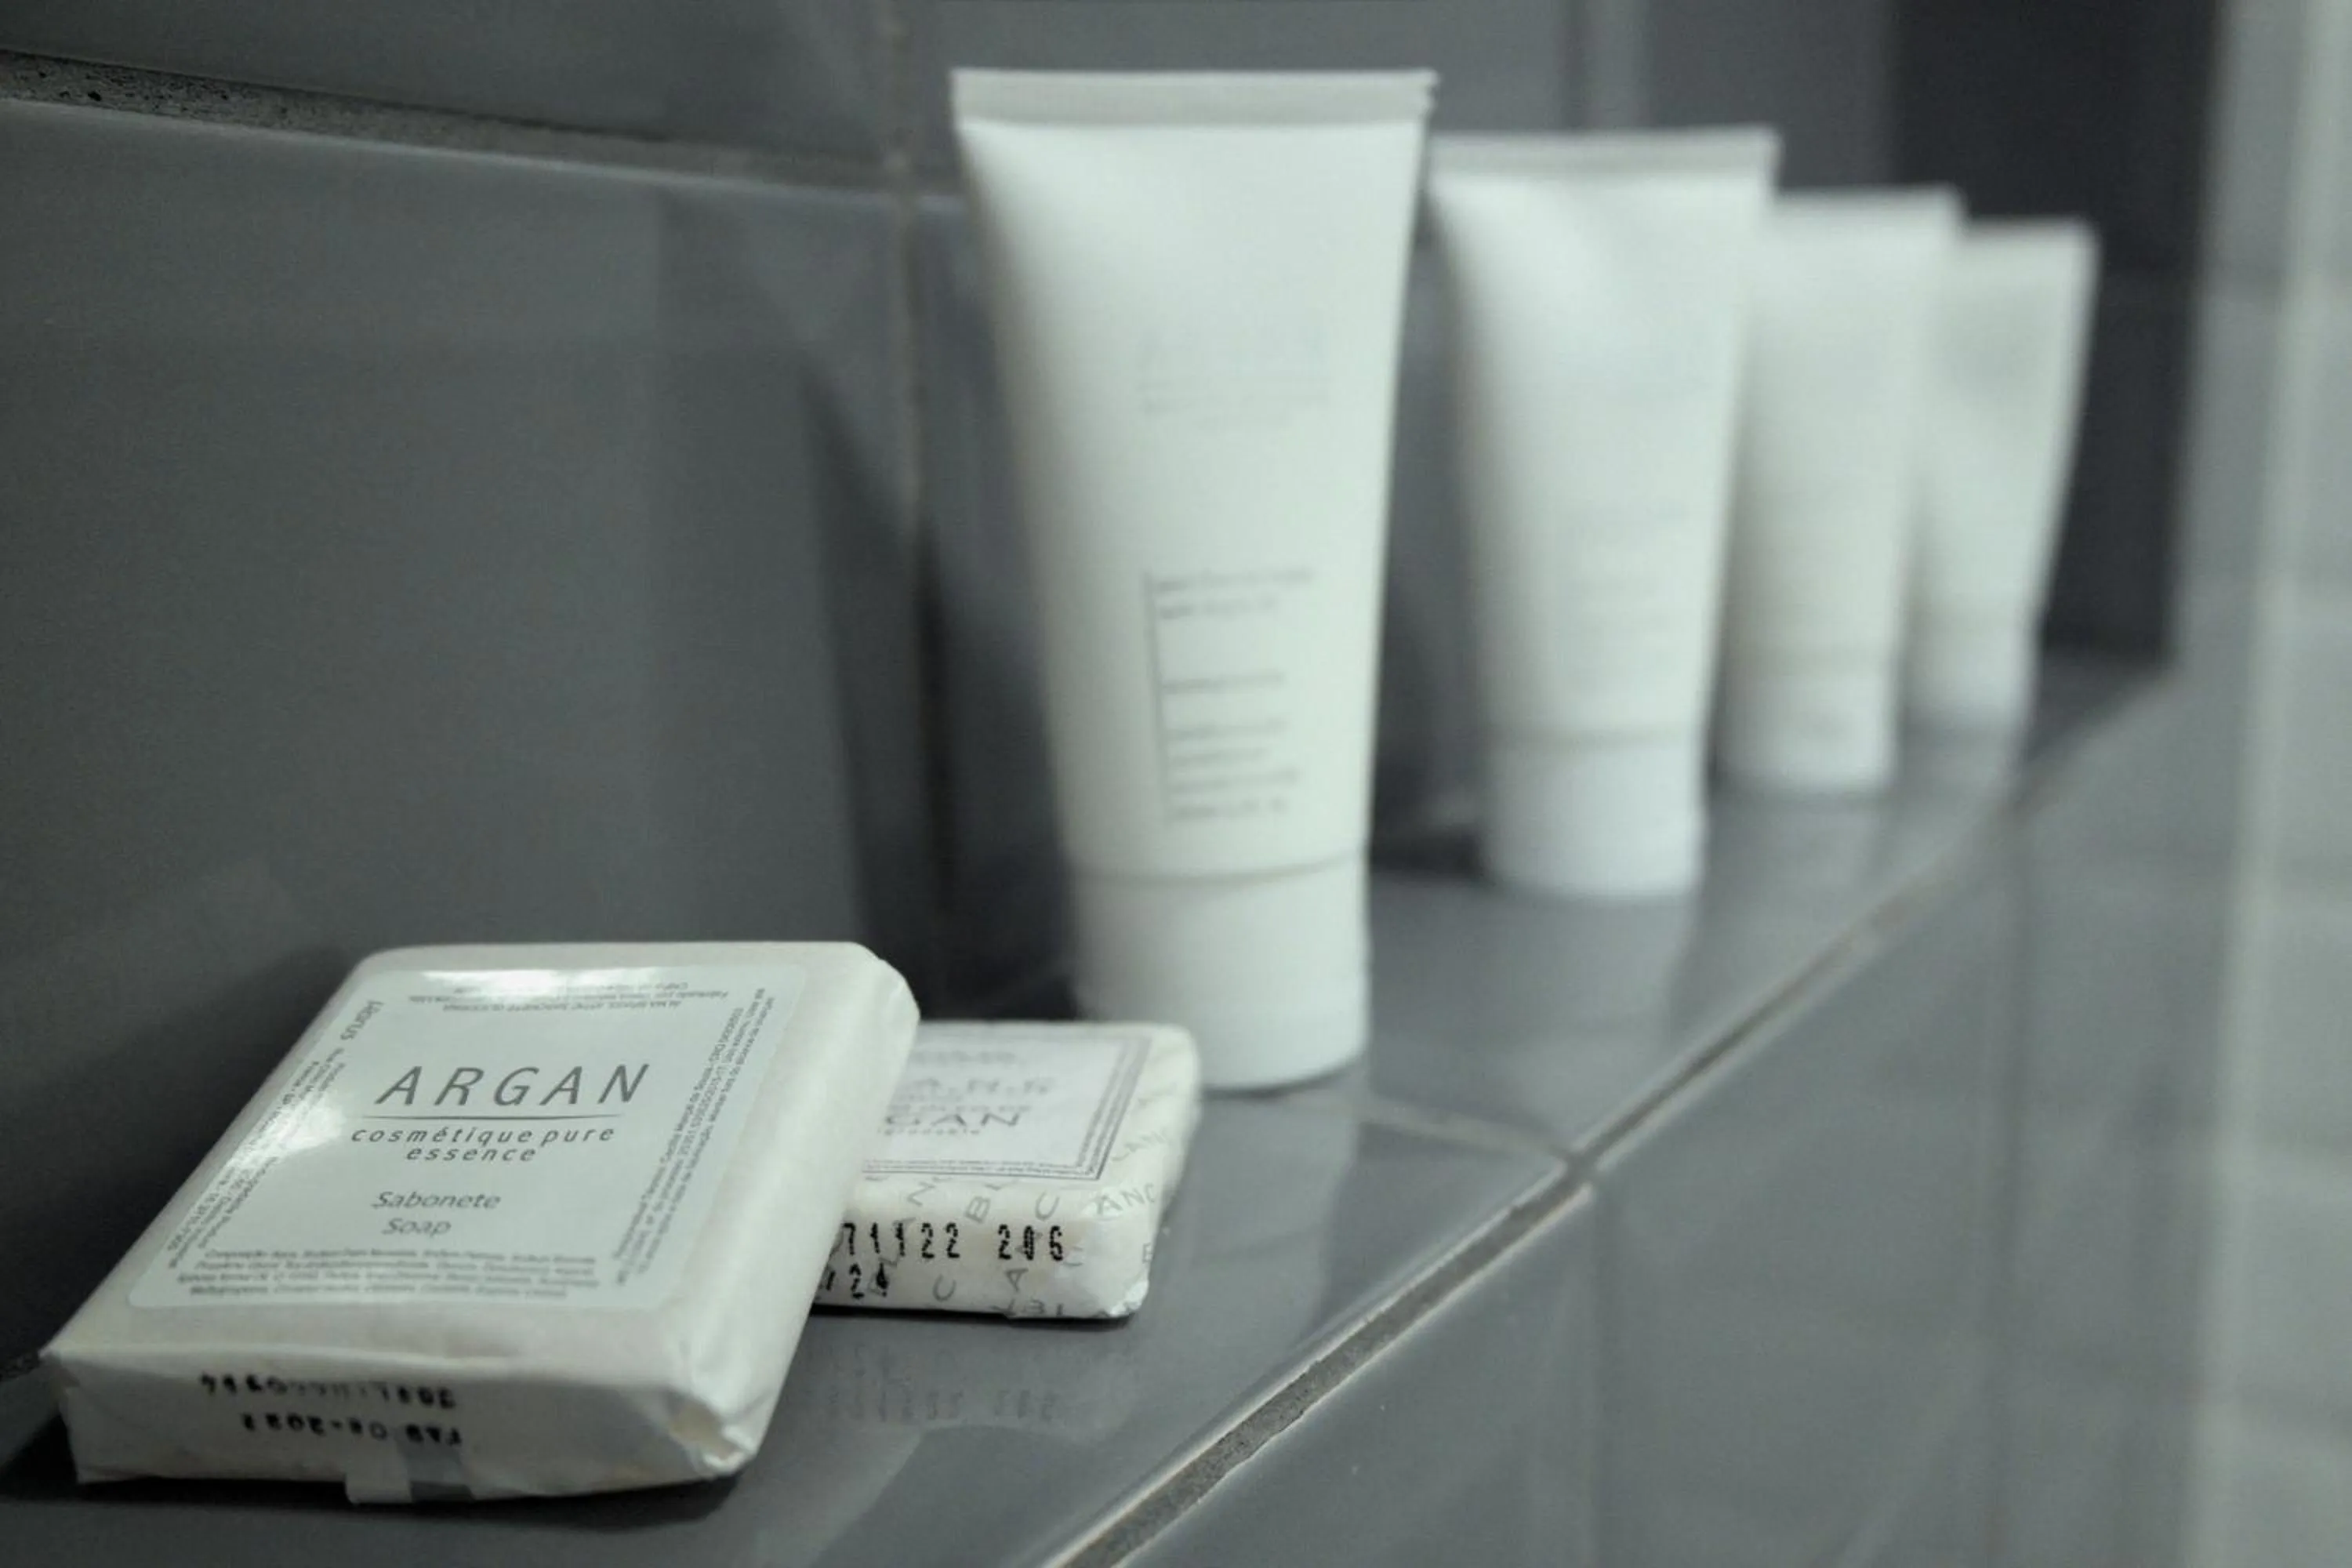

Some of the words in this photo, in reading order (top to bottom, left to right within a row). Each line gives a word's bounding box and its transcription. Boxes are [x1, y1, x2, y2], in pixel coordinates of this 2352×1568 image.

[375, 1063, 649, 1106] ARGAN
[350, 1126, 533, 1148] cosmétique
[540, 1127, 615, 1148] pure
[406, 1146, 536, 1162] essence
[371, 1190, 502, 1210] Sabonete
[381, 1217, 452, 1237] Soap
[997, 1224, 1064, 1261] 206
